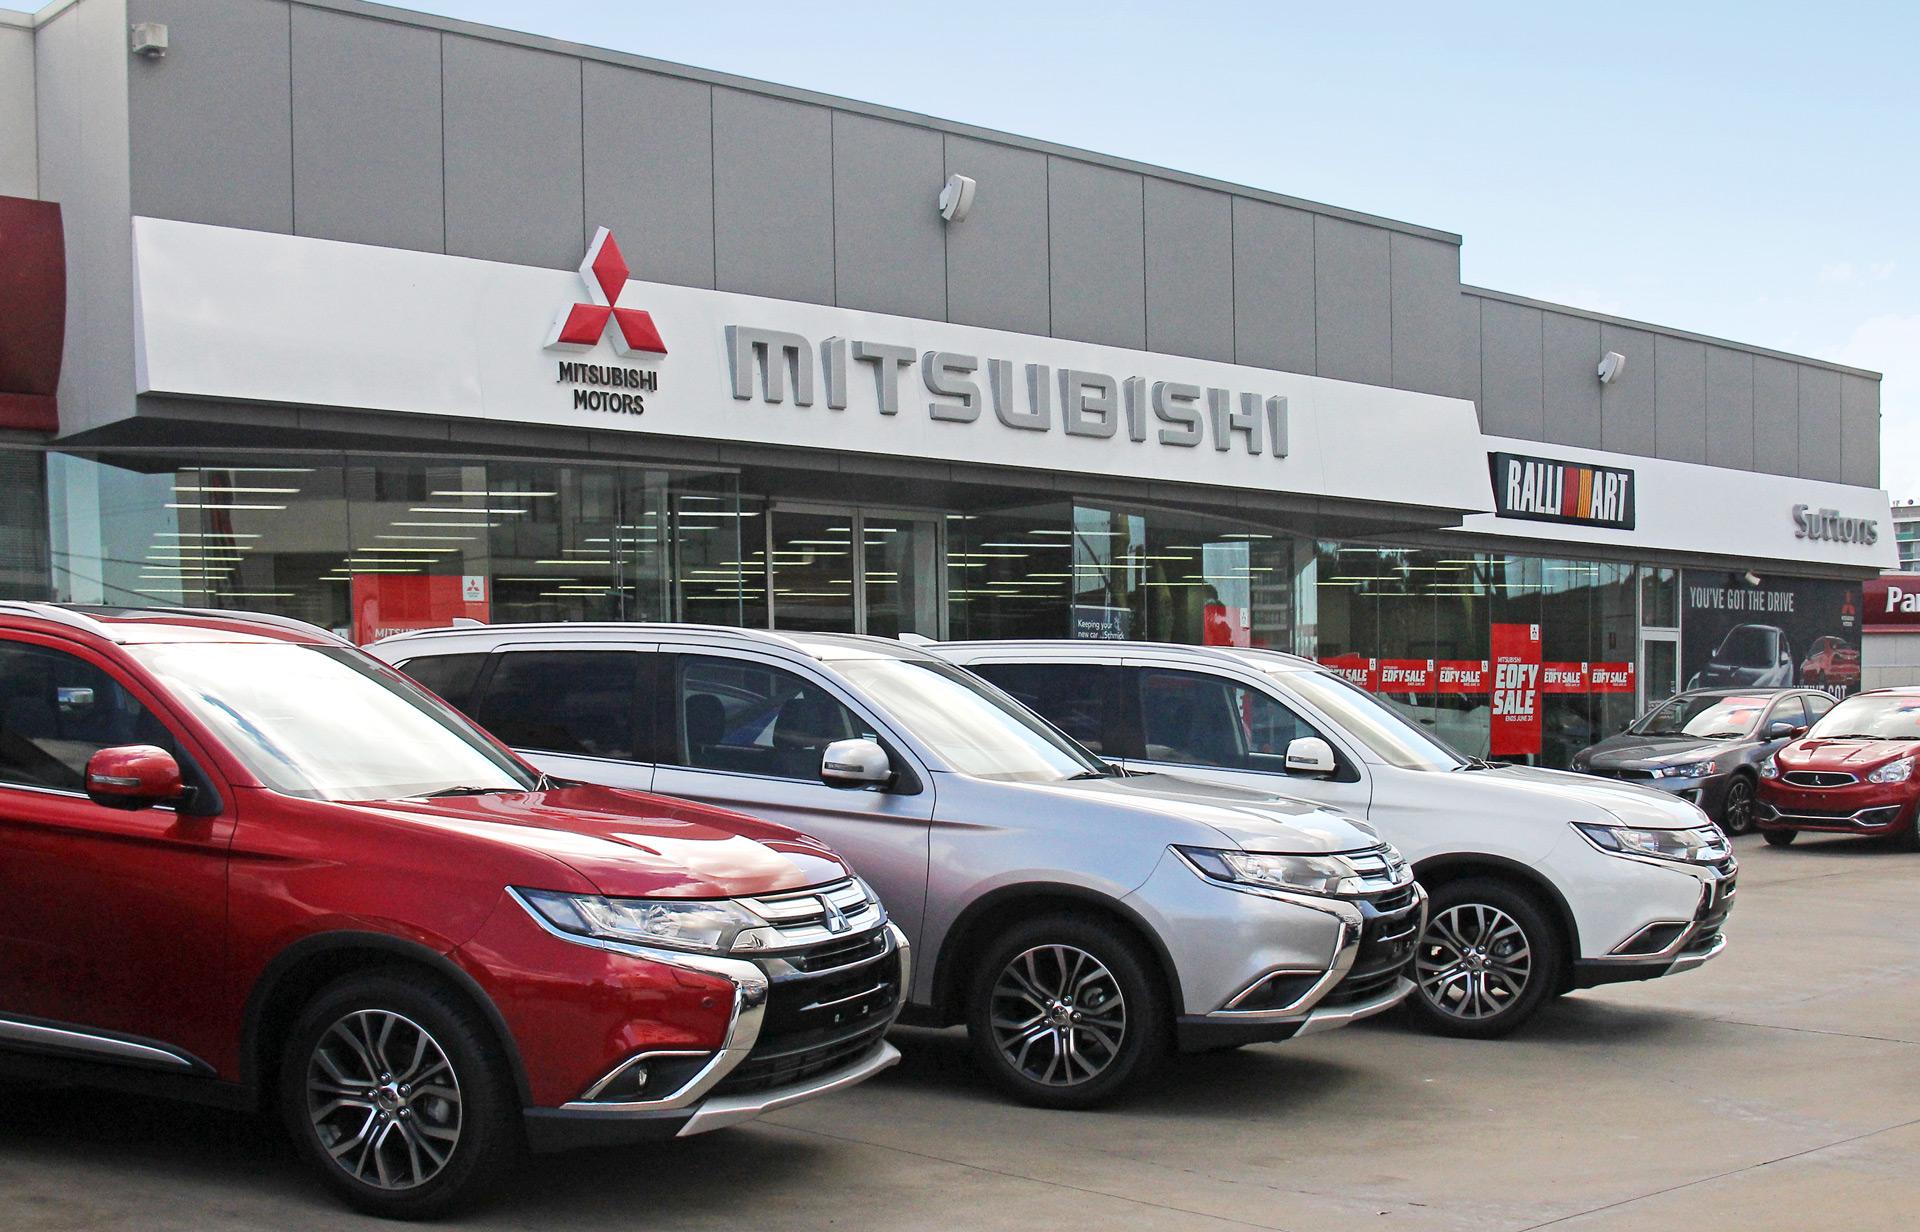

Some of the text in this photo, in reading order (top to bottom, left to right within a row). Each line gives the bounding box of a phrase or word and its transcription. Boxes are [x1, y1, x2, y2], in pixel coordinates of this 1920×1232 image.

[557, 361, 658, 391] MITSUBISHI
[725, 325, 1288, 458] MITSUBISHI
[574, 389, 644, 415] MOTORS
[1792, 503, 1878, 545] Suttons
[1690, 586, 1794, 612] YOU'VE GOT THE DRIVE
[1078, 619, 1112, 631] Keeping your
[1090, 631, 1098, 639] car
[1345, 669, 1368, 682] SALE
[1382, 669, 1426, 683] EOFY SALE
[1440, 670, 1480, 683] EOFY SALE
[1495, 663, 1539, 689] EOFY
[1544, 671, 1580, 684] EOFY SALE
[1592, 672, 1628, 684] EOFY SALE
[1492, 689, 1535, 715] SALE
